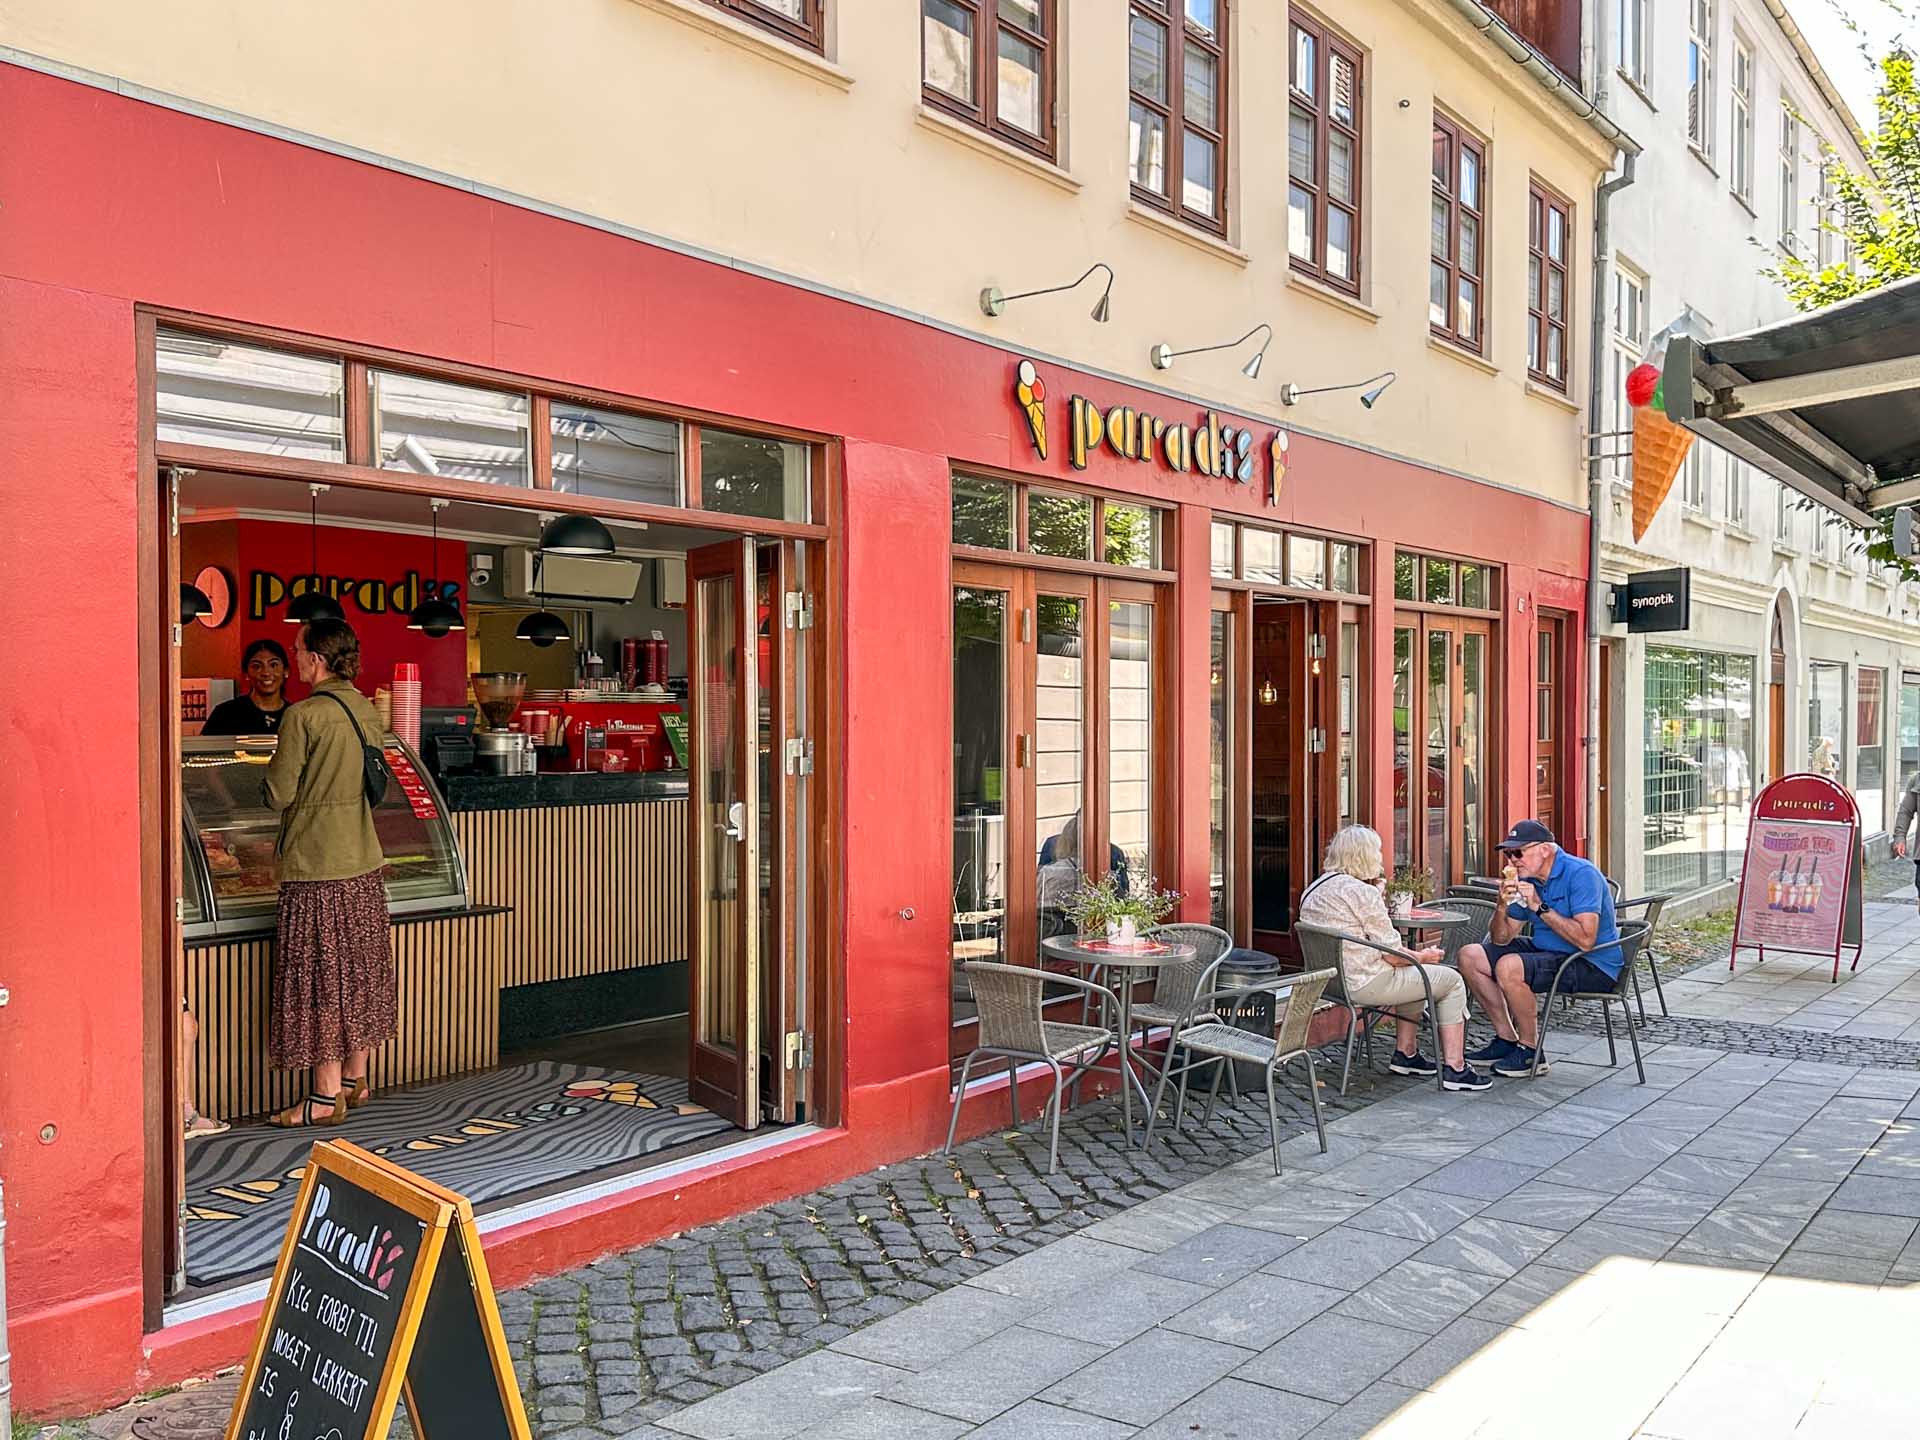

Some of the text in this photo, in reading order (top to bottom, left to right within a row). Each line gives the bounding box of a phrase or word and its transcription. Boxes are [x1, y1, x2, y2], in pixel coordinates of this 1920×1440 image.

[1071, 394, 1253, 484] paradis
[1632, 593, 1674, 608] synoptik
[1773, 799, 1835, 811] paradis
[302, 1183, 404, 1291] Paradis
[285, 1267, 380, 1359] KIG FORBI TIL
[259, 1365, 279, 1398] IS
[271, 1326, 369, 1413] NOGET LÆKKERT
